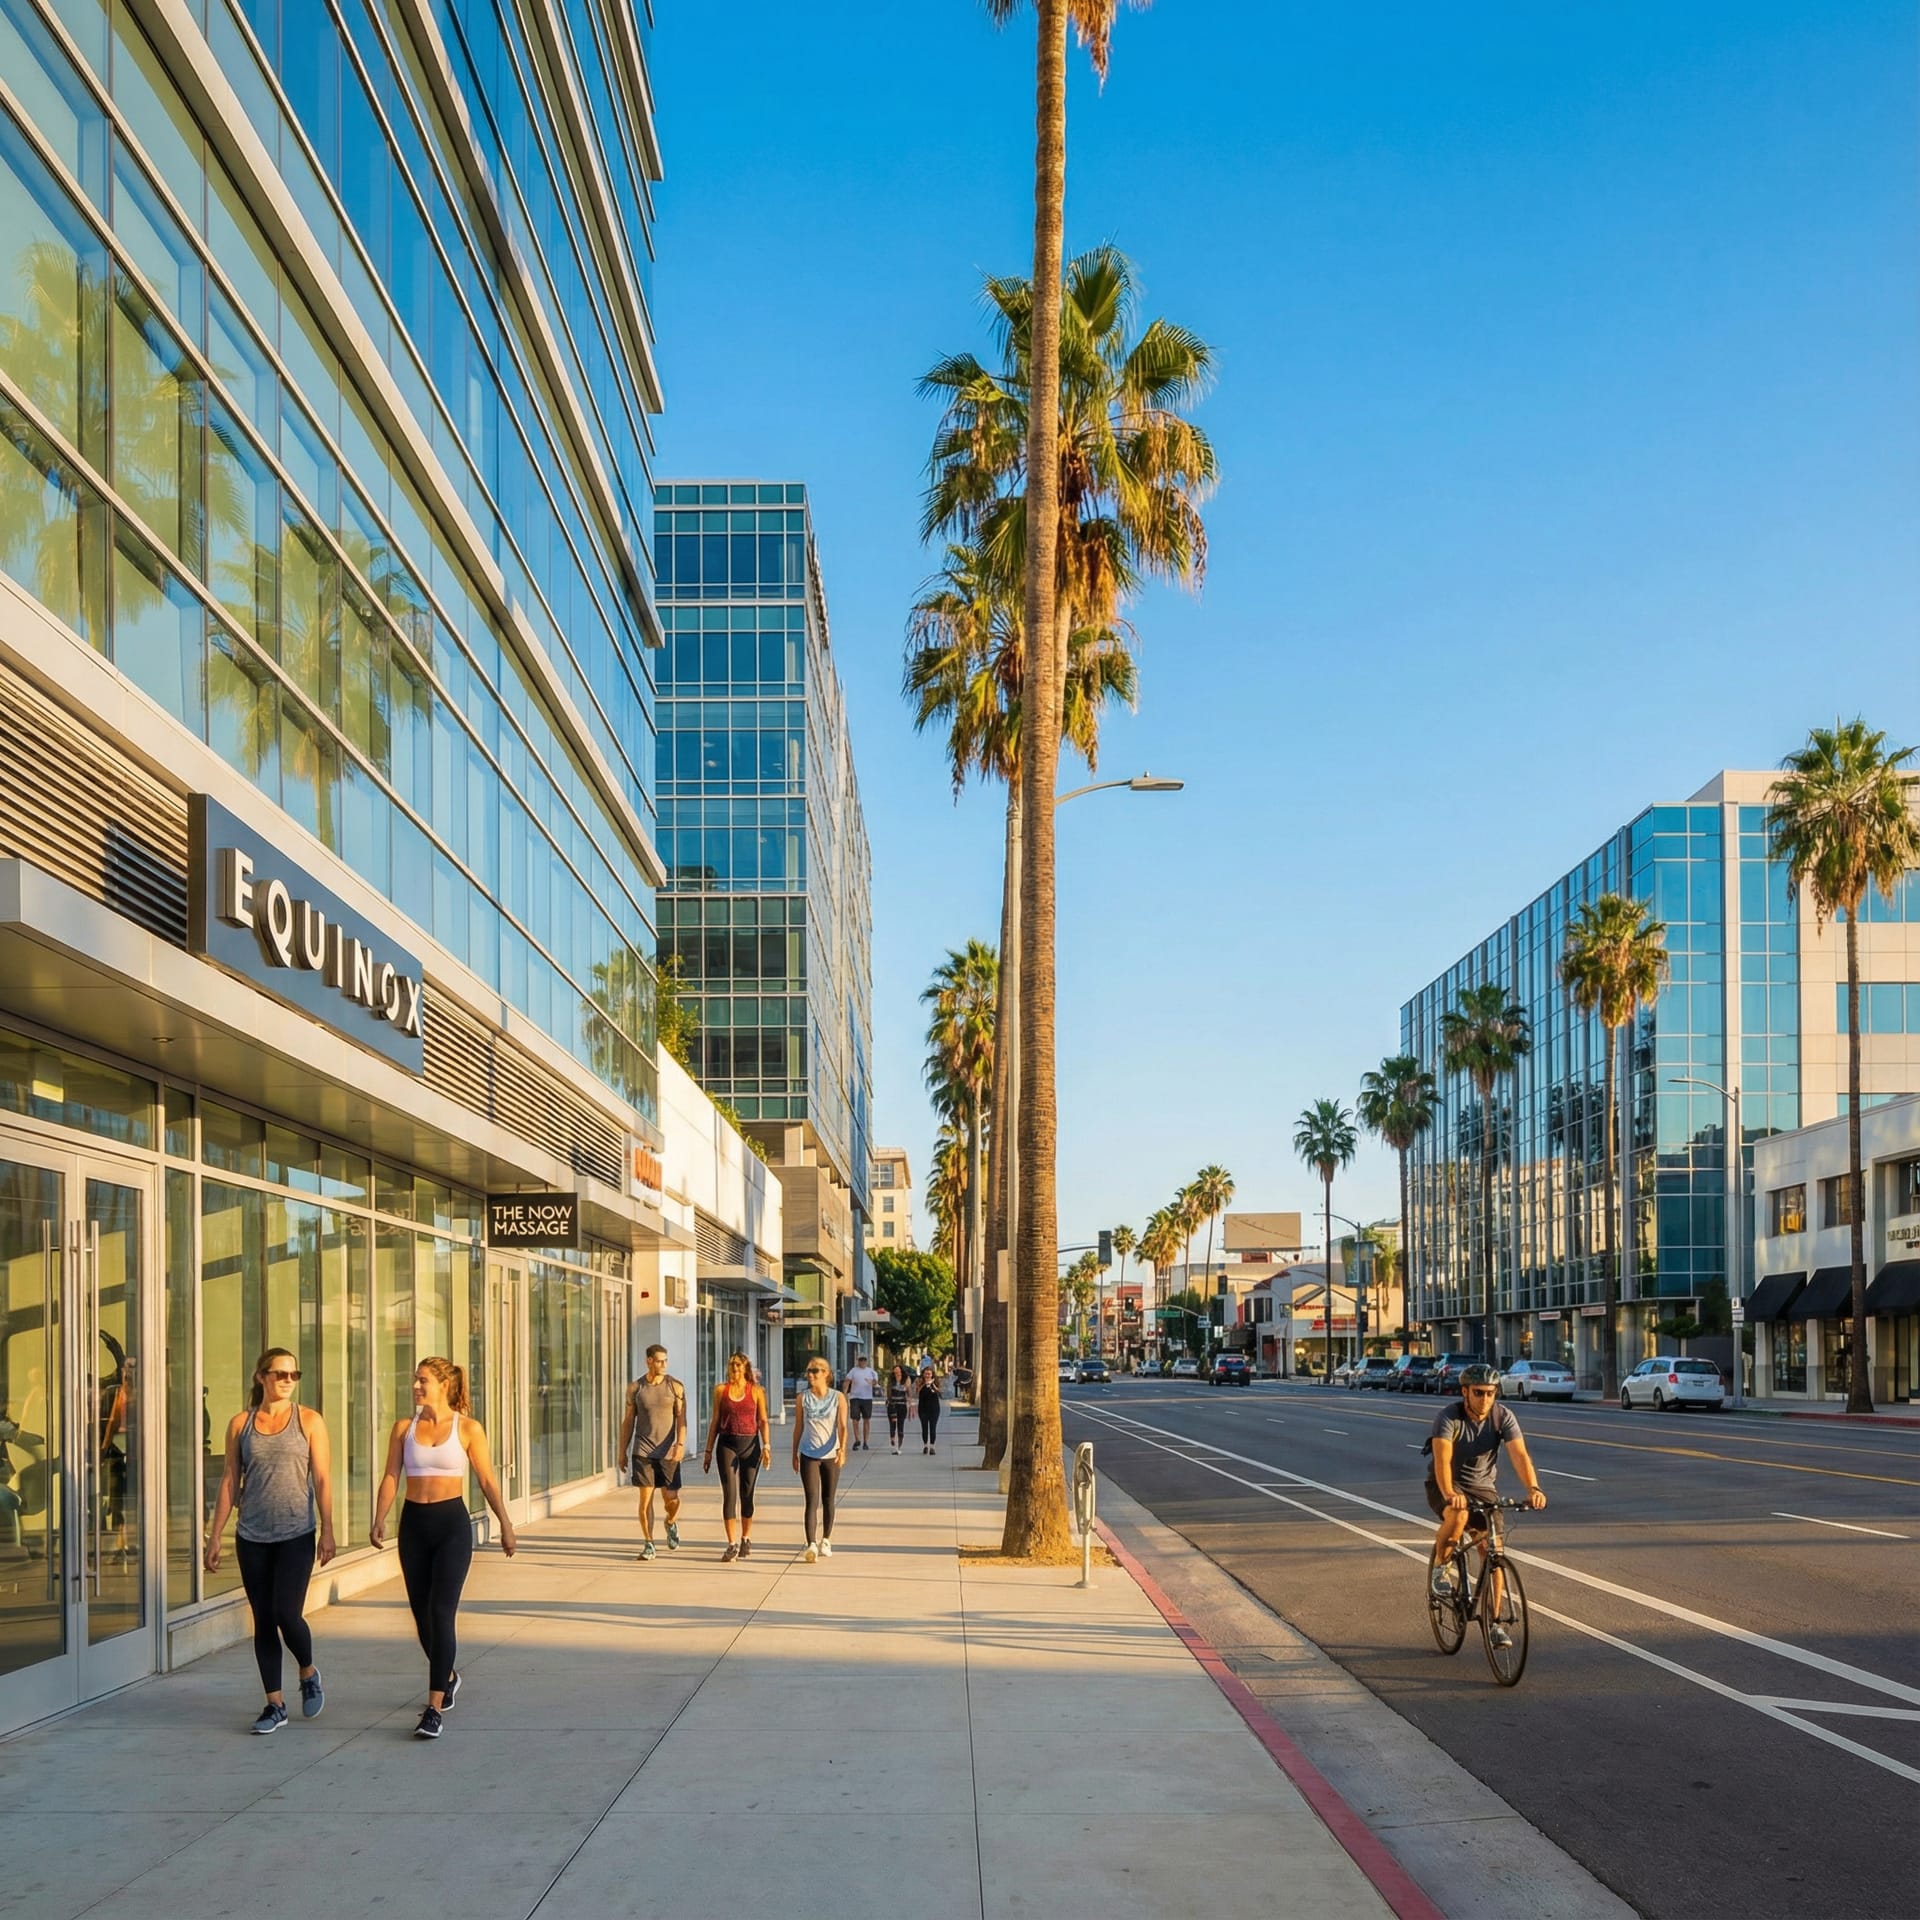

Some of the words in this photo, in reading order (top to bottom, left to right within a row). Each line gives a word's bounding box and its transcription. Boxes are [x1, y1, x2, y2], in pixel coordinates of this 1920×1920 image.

[220, 847, 421, 1038] EQUINOX
[492, 1205, 524, 1220] THE
[528, 1205, 573, 1220] NOW
[494, 1221, 569, 1236] MASSAGE
